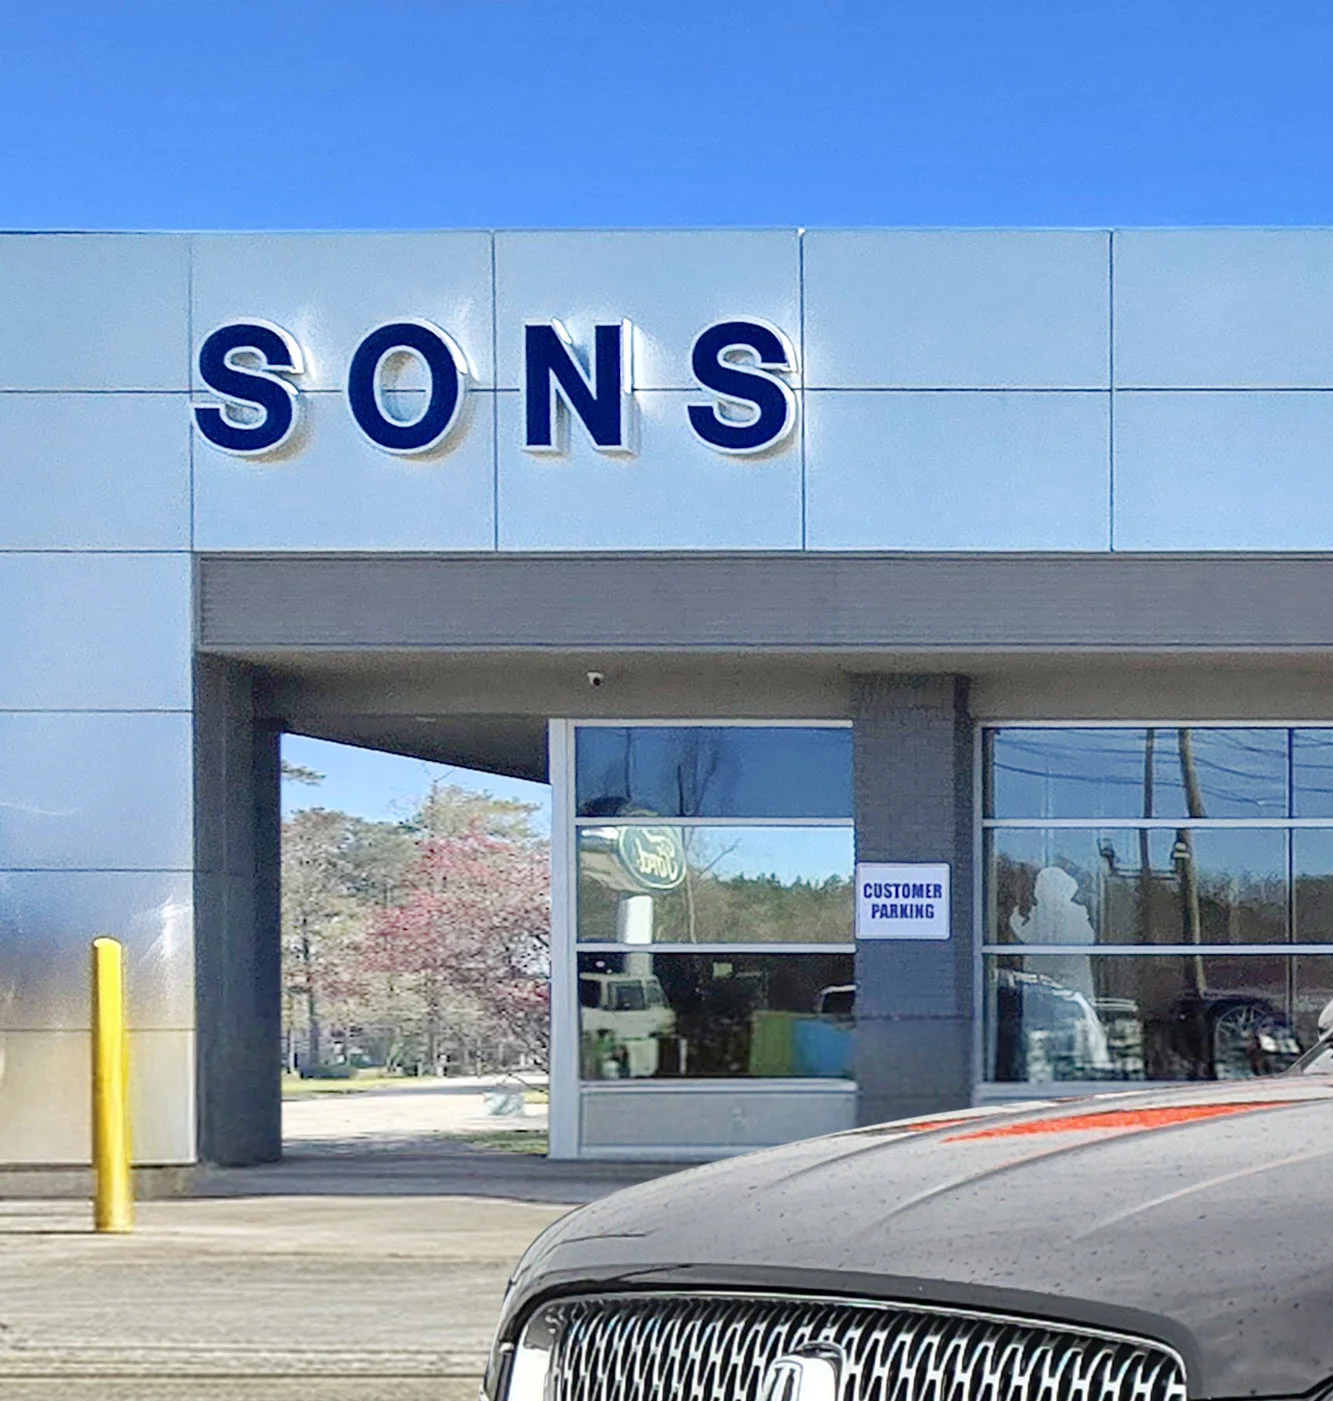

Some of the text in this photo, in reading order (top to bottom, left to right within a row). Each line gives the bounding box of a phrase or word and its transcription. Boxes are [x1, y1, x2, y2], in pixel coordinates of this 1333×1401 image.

[192, 320, 798, 455] SONS
[863, 883, 942, 899] CUSTOMER
[871, 903, 935, 919] PARKING
